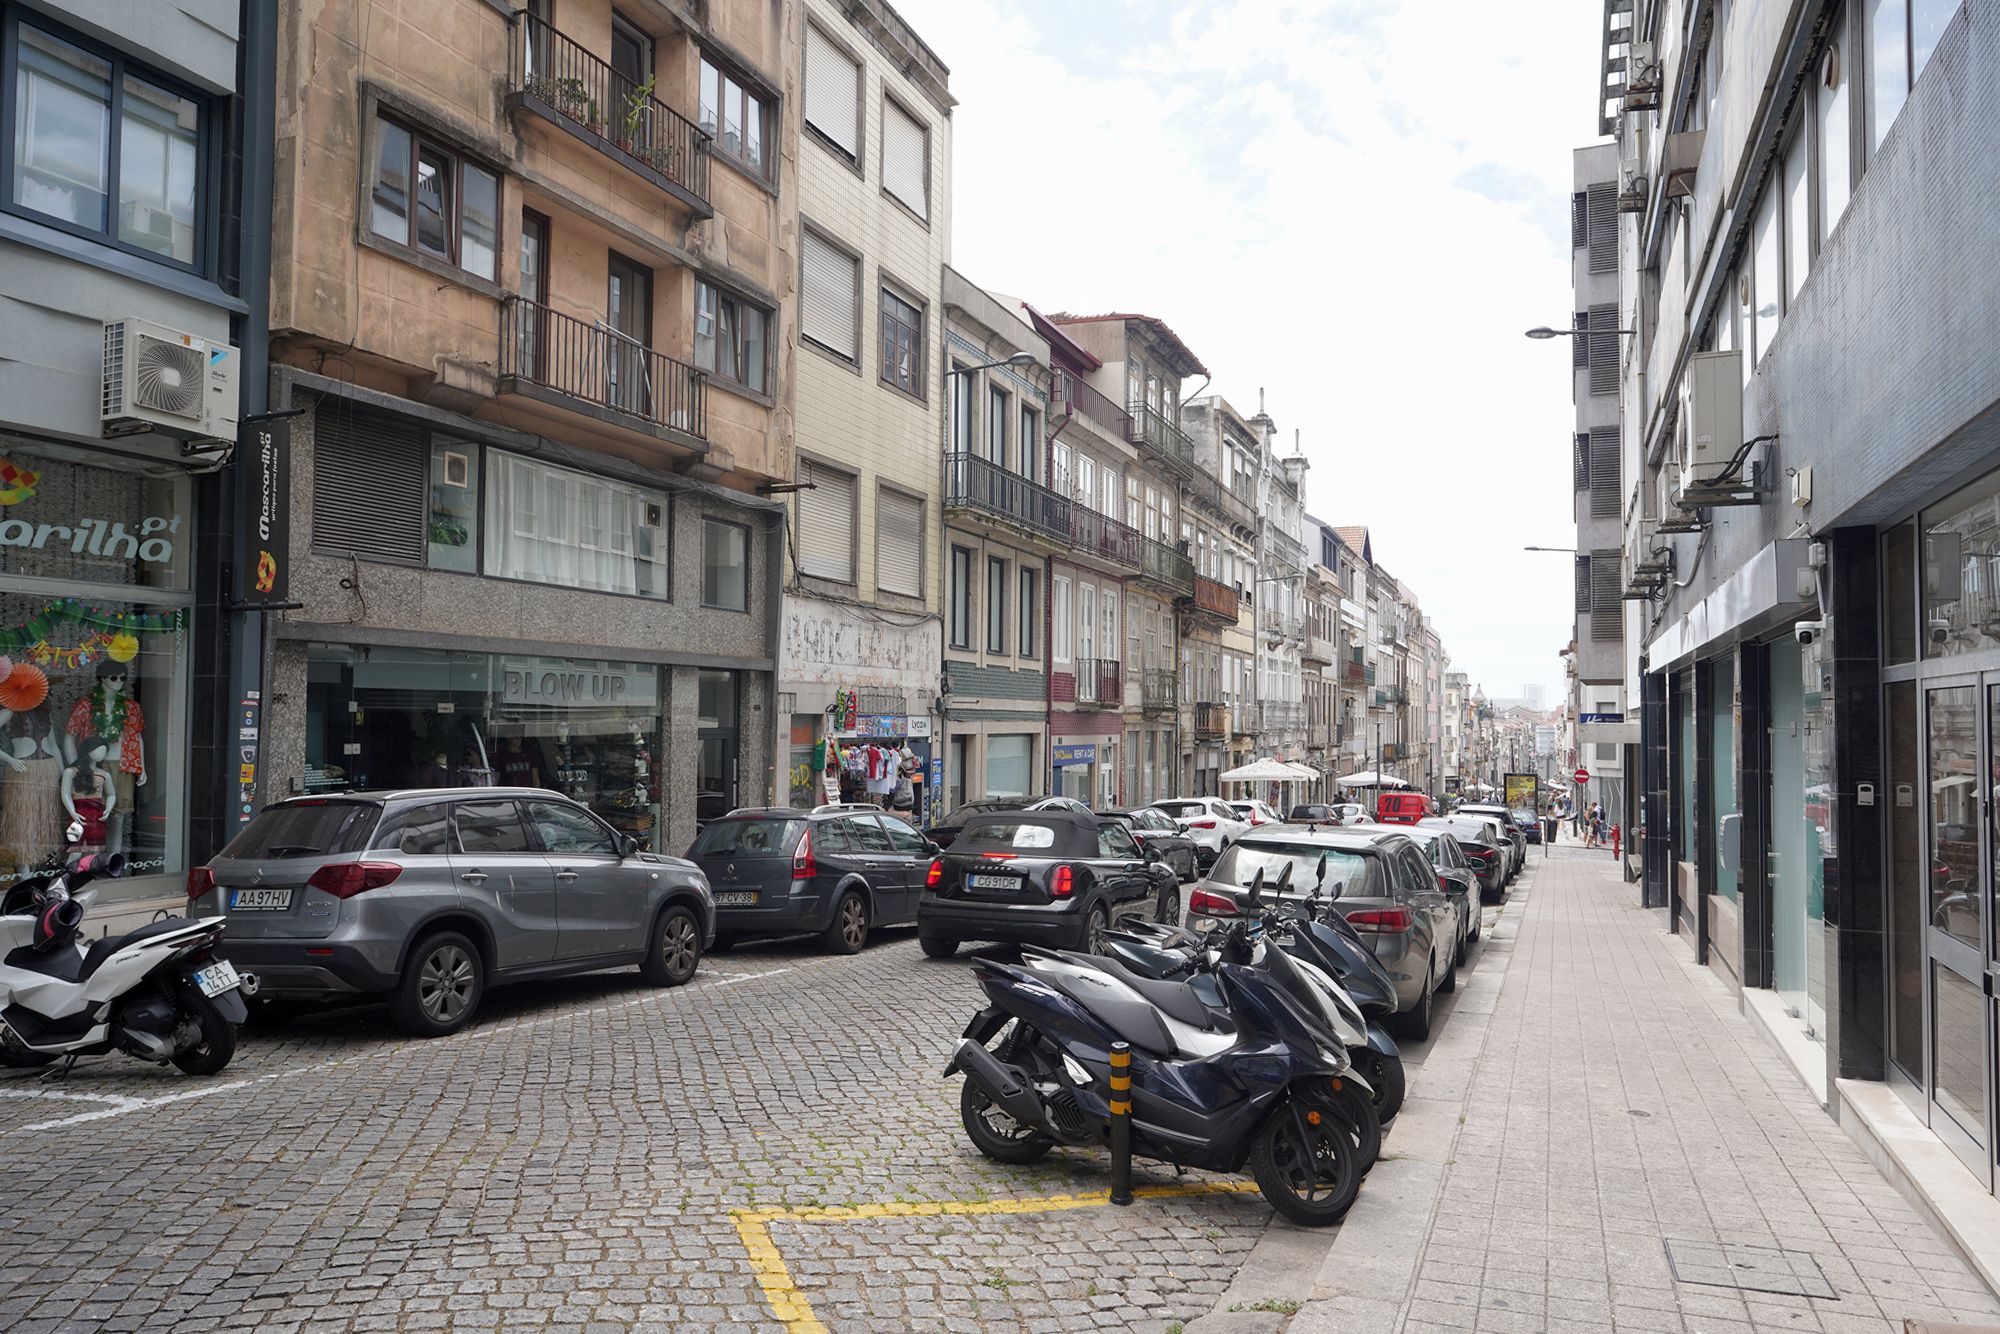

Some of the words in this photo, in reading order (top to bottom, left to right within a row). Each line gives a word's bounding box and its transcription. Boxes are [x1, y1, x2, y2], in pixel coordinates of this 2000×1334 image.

[504, 671, 584, 701] BLOW
[592, 674, 626, 701] UP
[1385, 797, 1401, 812] 70
[204, 966, 224, 979] CA
[206, 973, 233, 992] 14TT
